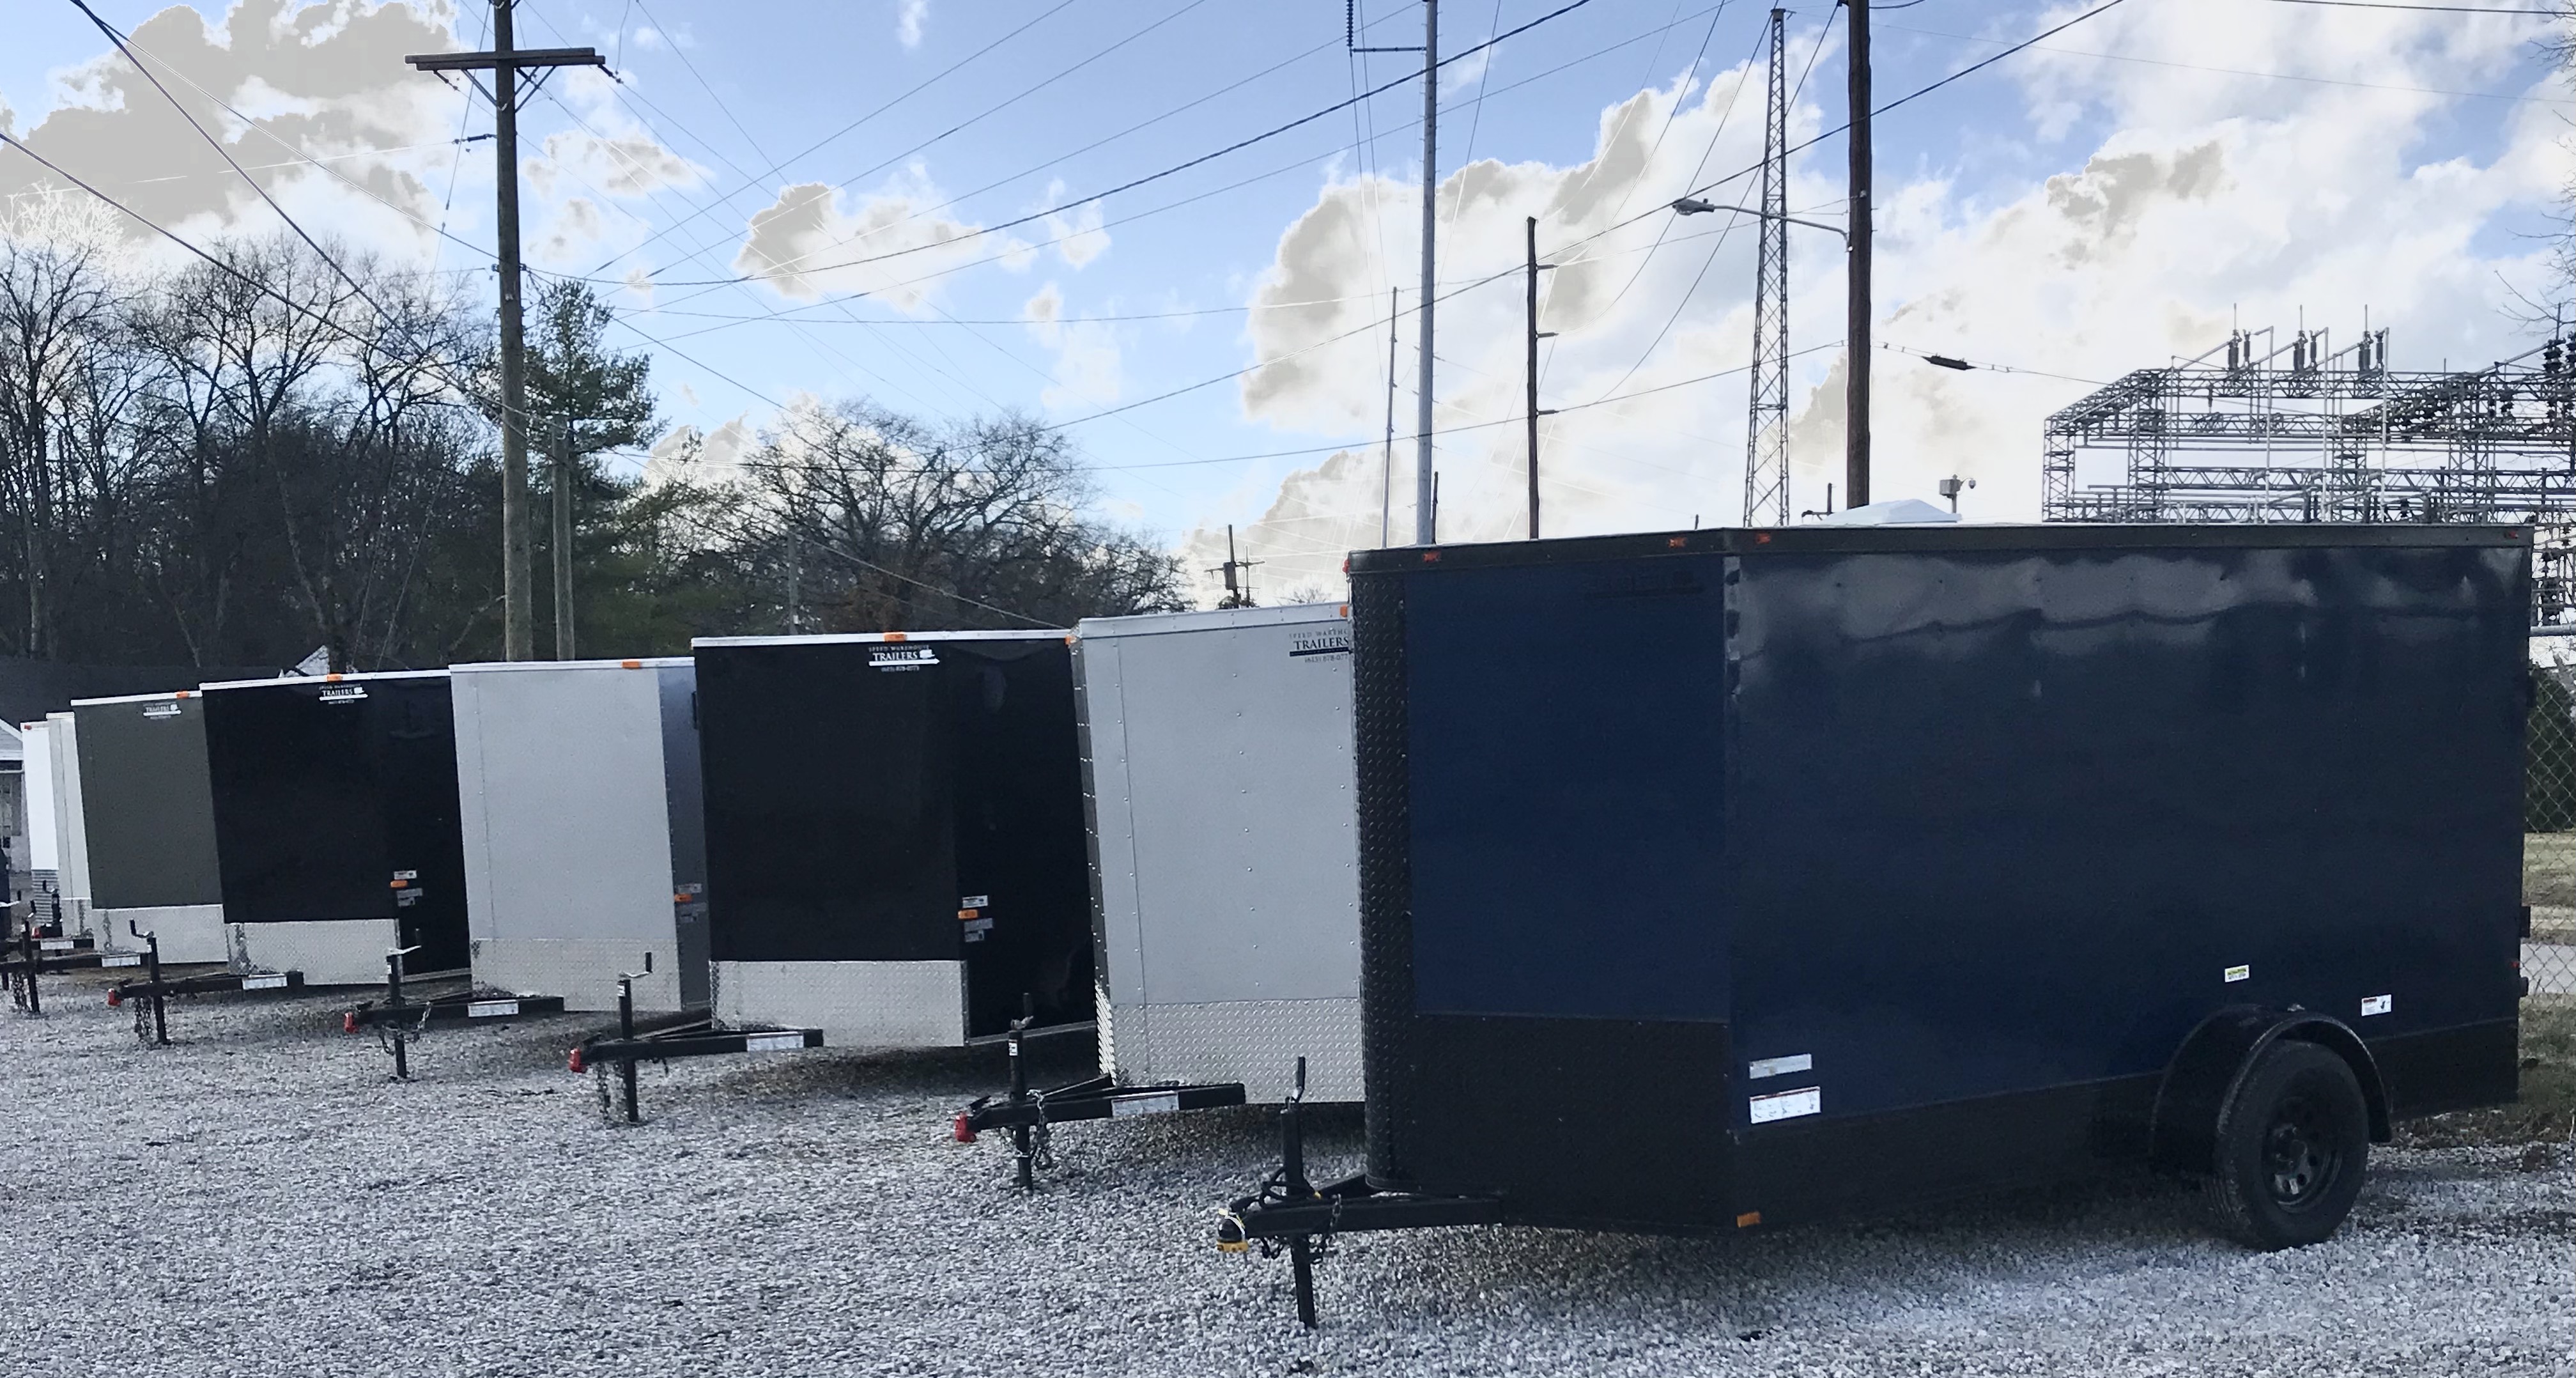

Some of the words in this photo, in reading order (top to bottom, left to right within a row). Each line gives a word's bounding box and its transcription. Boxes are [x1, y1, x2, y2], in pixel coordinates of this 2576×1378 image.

[1293, 637, 1349, 650] TRAILERS
[872, 651, 918, 662] TRAILERS
[322, 688, 353, 697] TRAILERS
